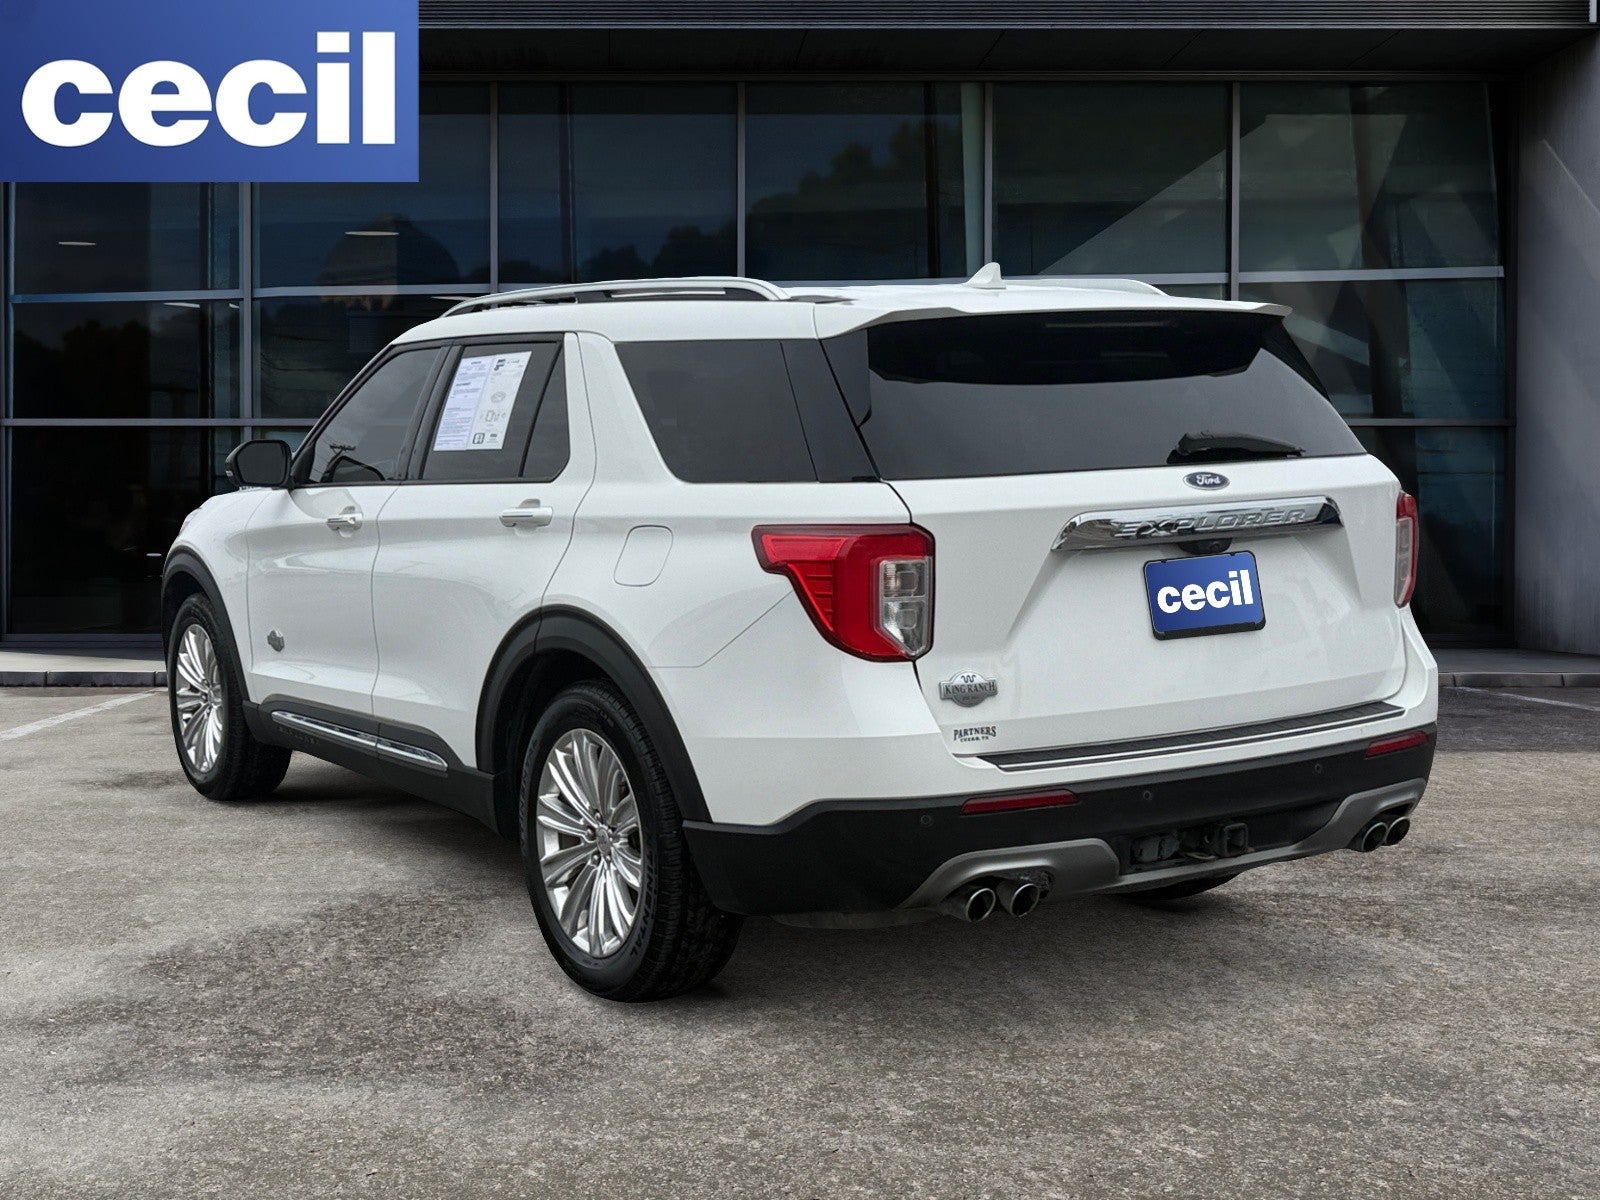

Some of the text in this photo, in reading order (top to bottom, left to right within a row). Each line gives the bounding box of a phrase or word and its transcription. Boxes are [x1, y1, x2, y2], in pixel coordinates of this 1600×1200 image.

[1196, 474, 1221, 485] Ford
[1113, 509, 1307, 538] EXPLORER
[1157, 569, 1254, 613] cecil
[945, 681, 995, 695] KING RANCH
[953, 726, 997, 741] PARTNERS
